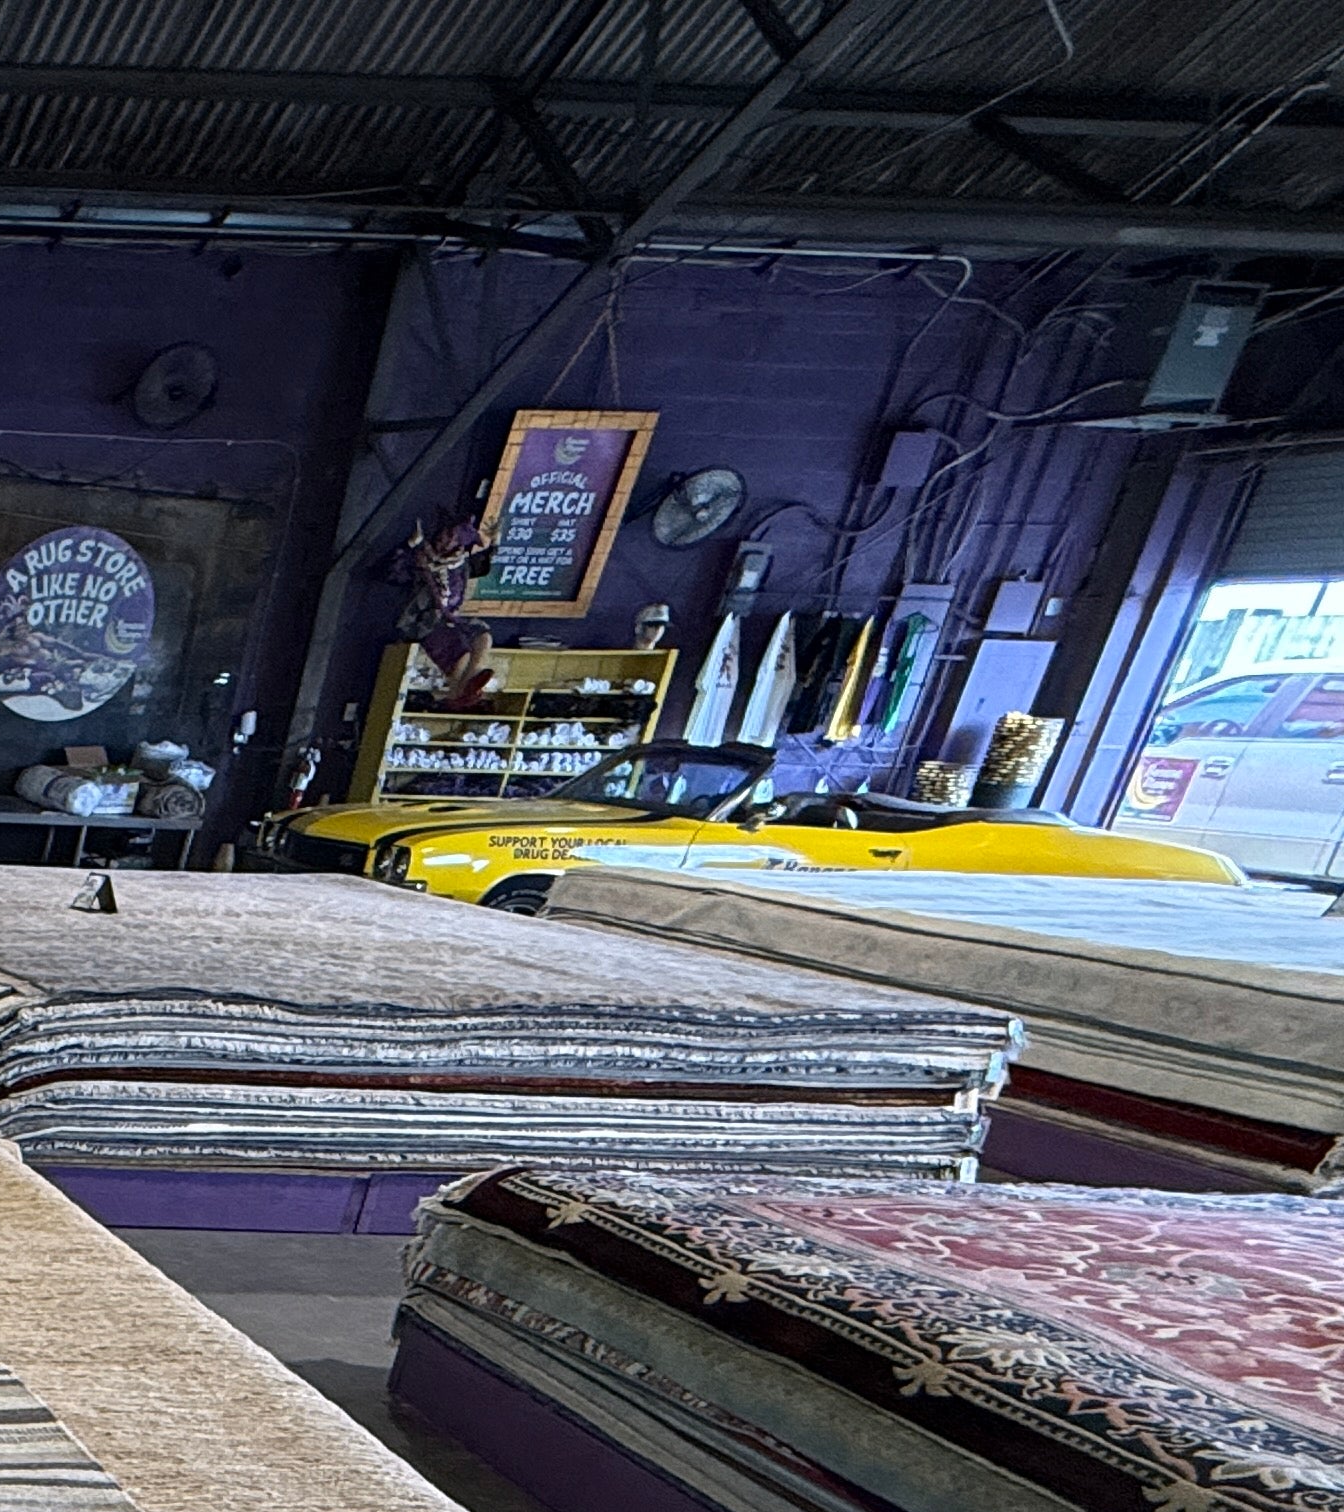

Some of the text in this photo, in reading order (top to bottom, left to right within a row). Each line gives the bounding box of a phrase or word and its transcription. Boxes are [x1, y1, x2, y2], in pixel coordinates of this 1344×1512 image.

[530, 470, 588, 490] OFFICIAL
[508, 491, 597, 516] MERCH
[5, 538, 147, 598] A RUG STORE
[498, 565, 555, 586] FREE
[30, 572, 119, 602] LIKE NO
[26, 599, 109, 629] OTHER
[488, 835, 548, 848] SUPPORT
[550, 836, 584, 849] YOUR
[513, 848, 549, 860] DRUG
